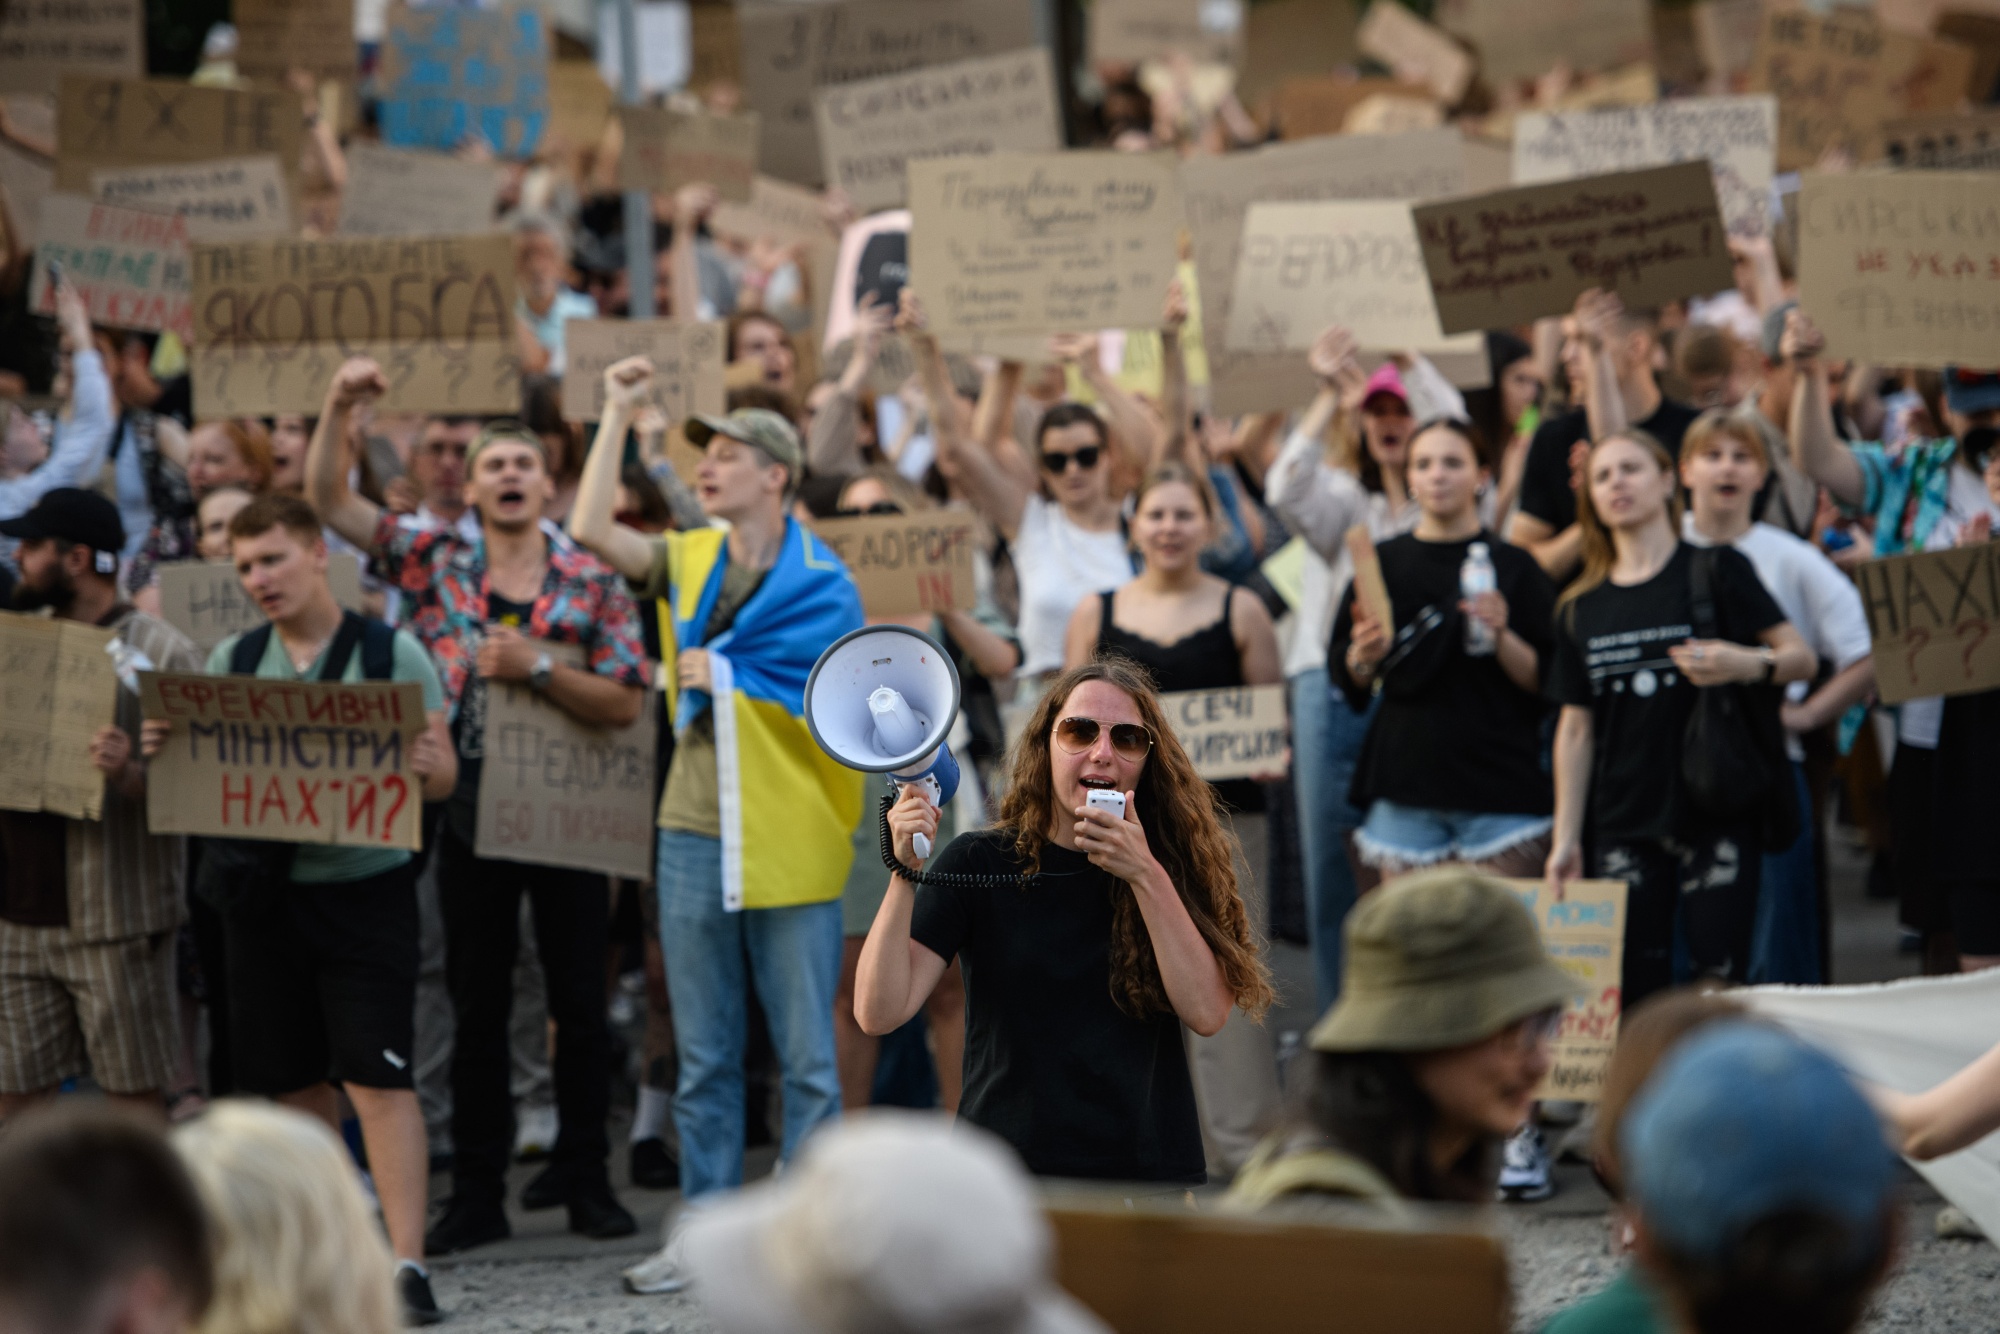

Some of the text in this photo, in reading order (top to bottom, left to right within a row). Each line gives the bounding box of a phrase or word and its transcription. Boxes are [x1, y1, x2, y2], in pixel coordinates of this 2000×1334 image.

[157, 677, 405, 725] ЕФЕКТИВНІ
[1180, 691, 1254, 728] СЕЧІ
[188, 719, 403, 771] МІНІСТРИ
